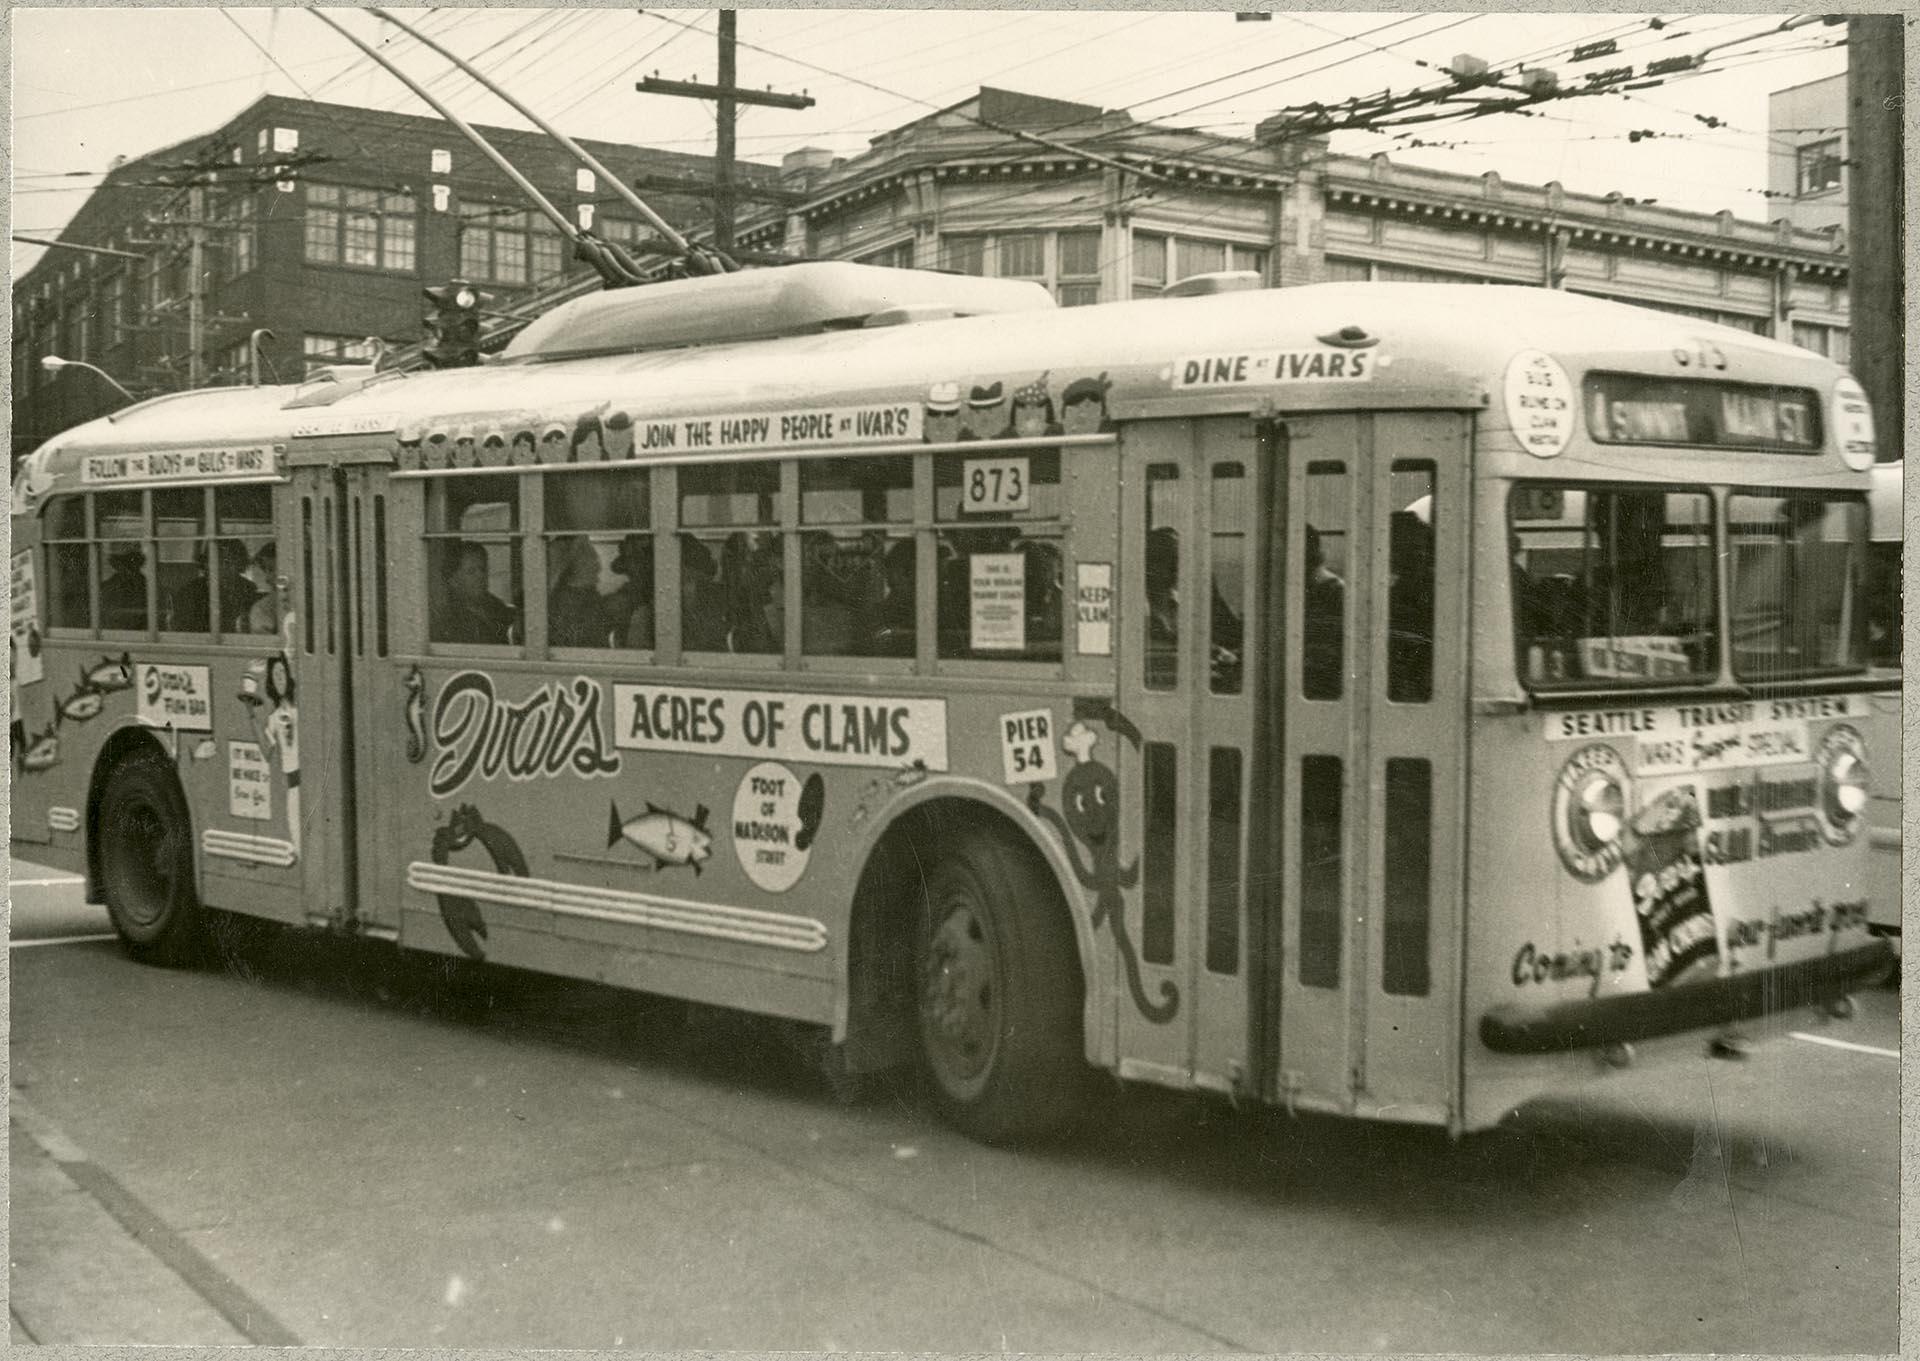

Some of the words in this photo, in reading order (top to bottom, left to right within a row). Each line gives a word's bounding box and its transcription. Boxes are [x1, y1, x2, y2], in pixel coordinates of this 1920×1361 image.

[1183, 356, 1249, 385] DINE
[641, 424, 676, 450] JOIN
[685, 421, 712, 446] THE
[721, 417, 770, 444] HAPPY
[781, 412, 833, 441] PEOPLE
[856, 407, 909, 437] IVAR'S
[89, 457, 128, 479] FOLLOW
[970, 467, 1022, 502] 873
[1081, 587, 1112, 603] KEEP
[1006, 716, 1049, 744] PIER
[1562, 709, 1656, 736] SEATTLE
[1677, 703, 1753, 729] TRANSIT
[1770, 698, 1848, 720] SYSTEM
[430, 669, 620, 797] Ivar's
[630, 693, 725, 744] ACRES
[742, 699, 785, 748] OF
[802, 703, 911, 756] CLAMS
[1013, 745, 1044, 773] 54
[751, 776, 786, 797] FOOT
[760, 800, 777, 818] OF
[734, 821, 790, 845] MADISON
[755, 849, 787, 866] STREET
[1511, 936, 1603, 999] Coming
[1608, 934, 1633, 972] to
